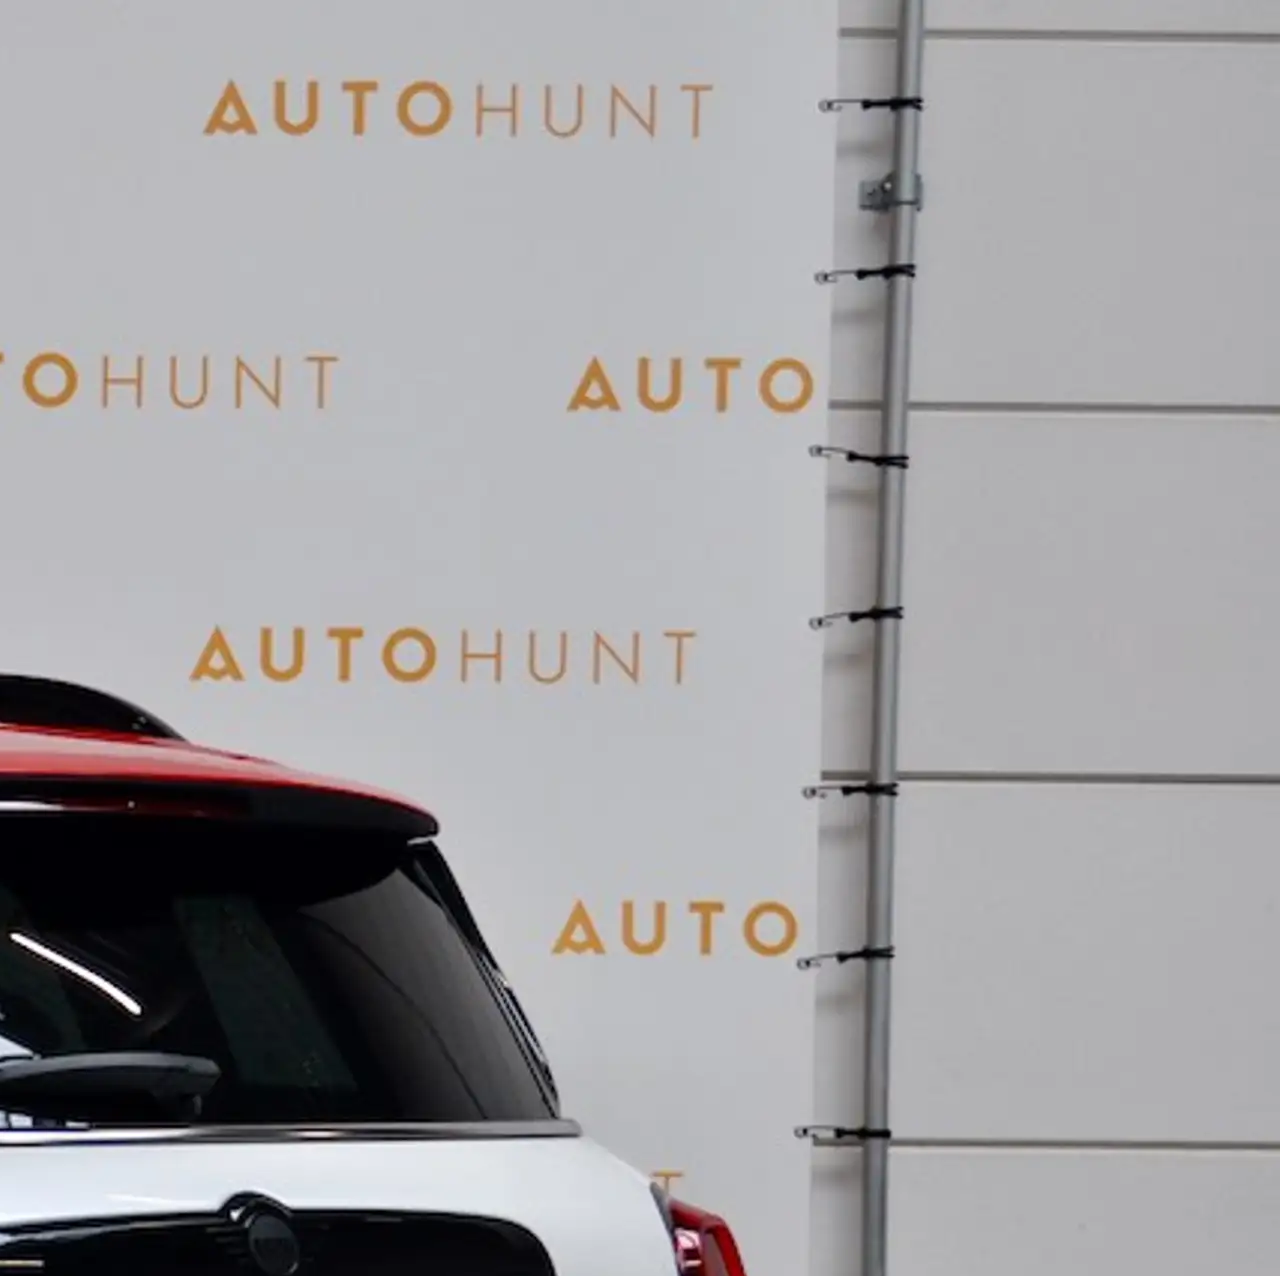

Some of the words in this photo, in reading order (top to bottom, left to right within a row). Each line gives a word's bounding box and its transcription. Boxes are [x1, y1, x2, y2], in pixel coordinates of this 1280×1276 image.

[206, 77, 711, 140] AUTOHUNT
[569, 356, 815, 414] AUTO
[191, 627, 699, 684] AUTOHUNT
[553, 899, 799, 957] AUTO
